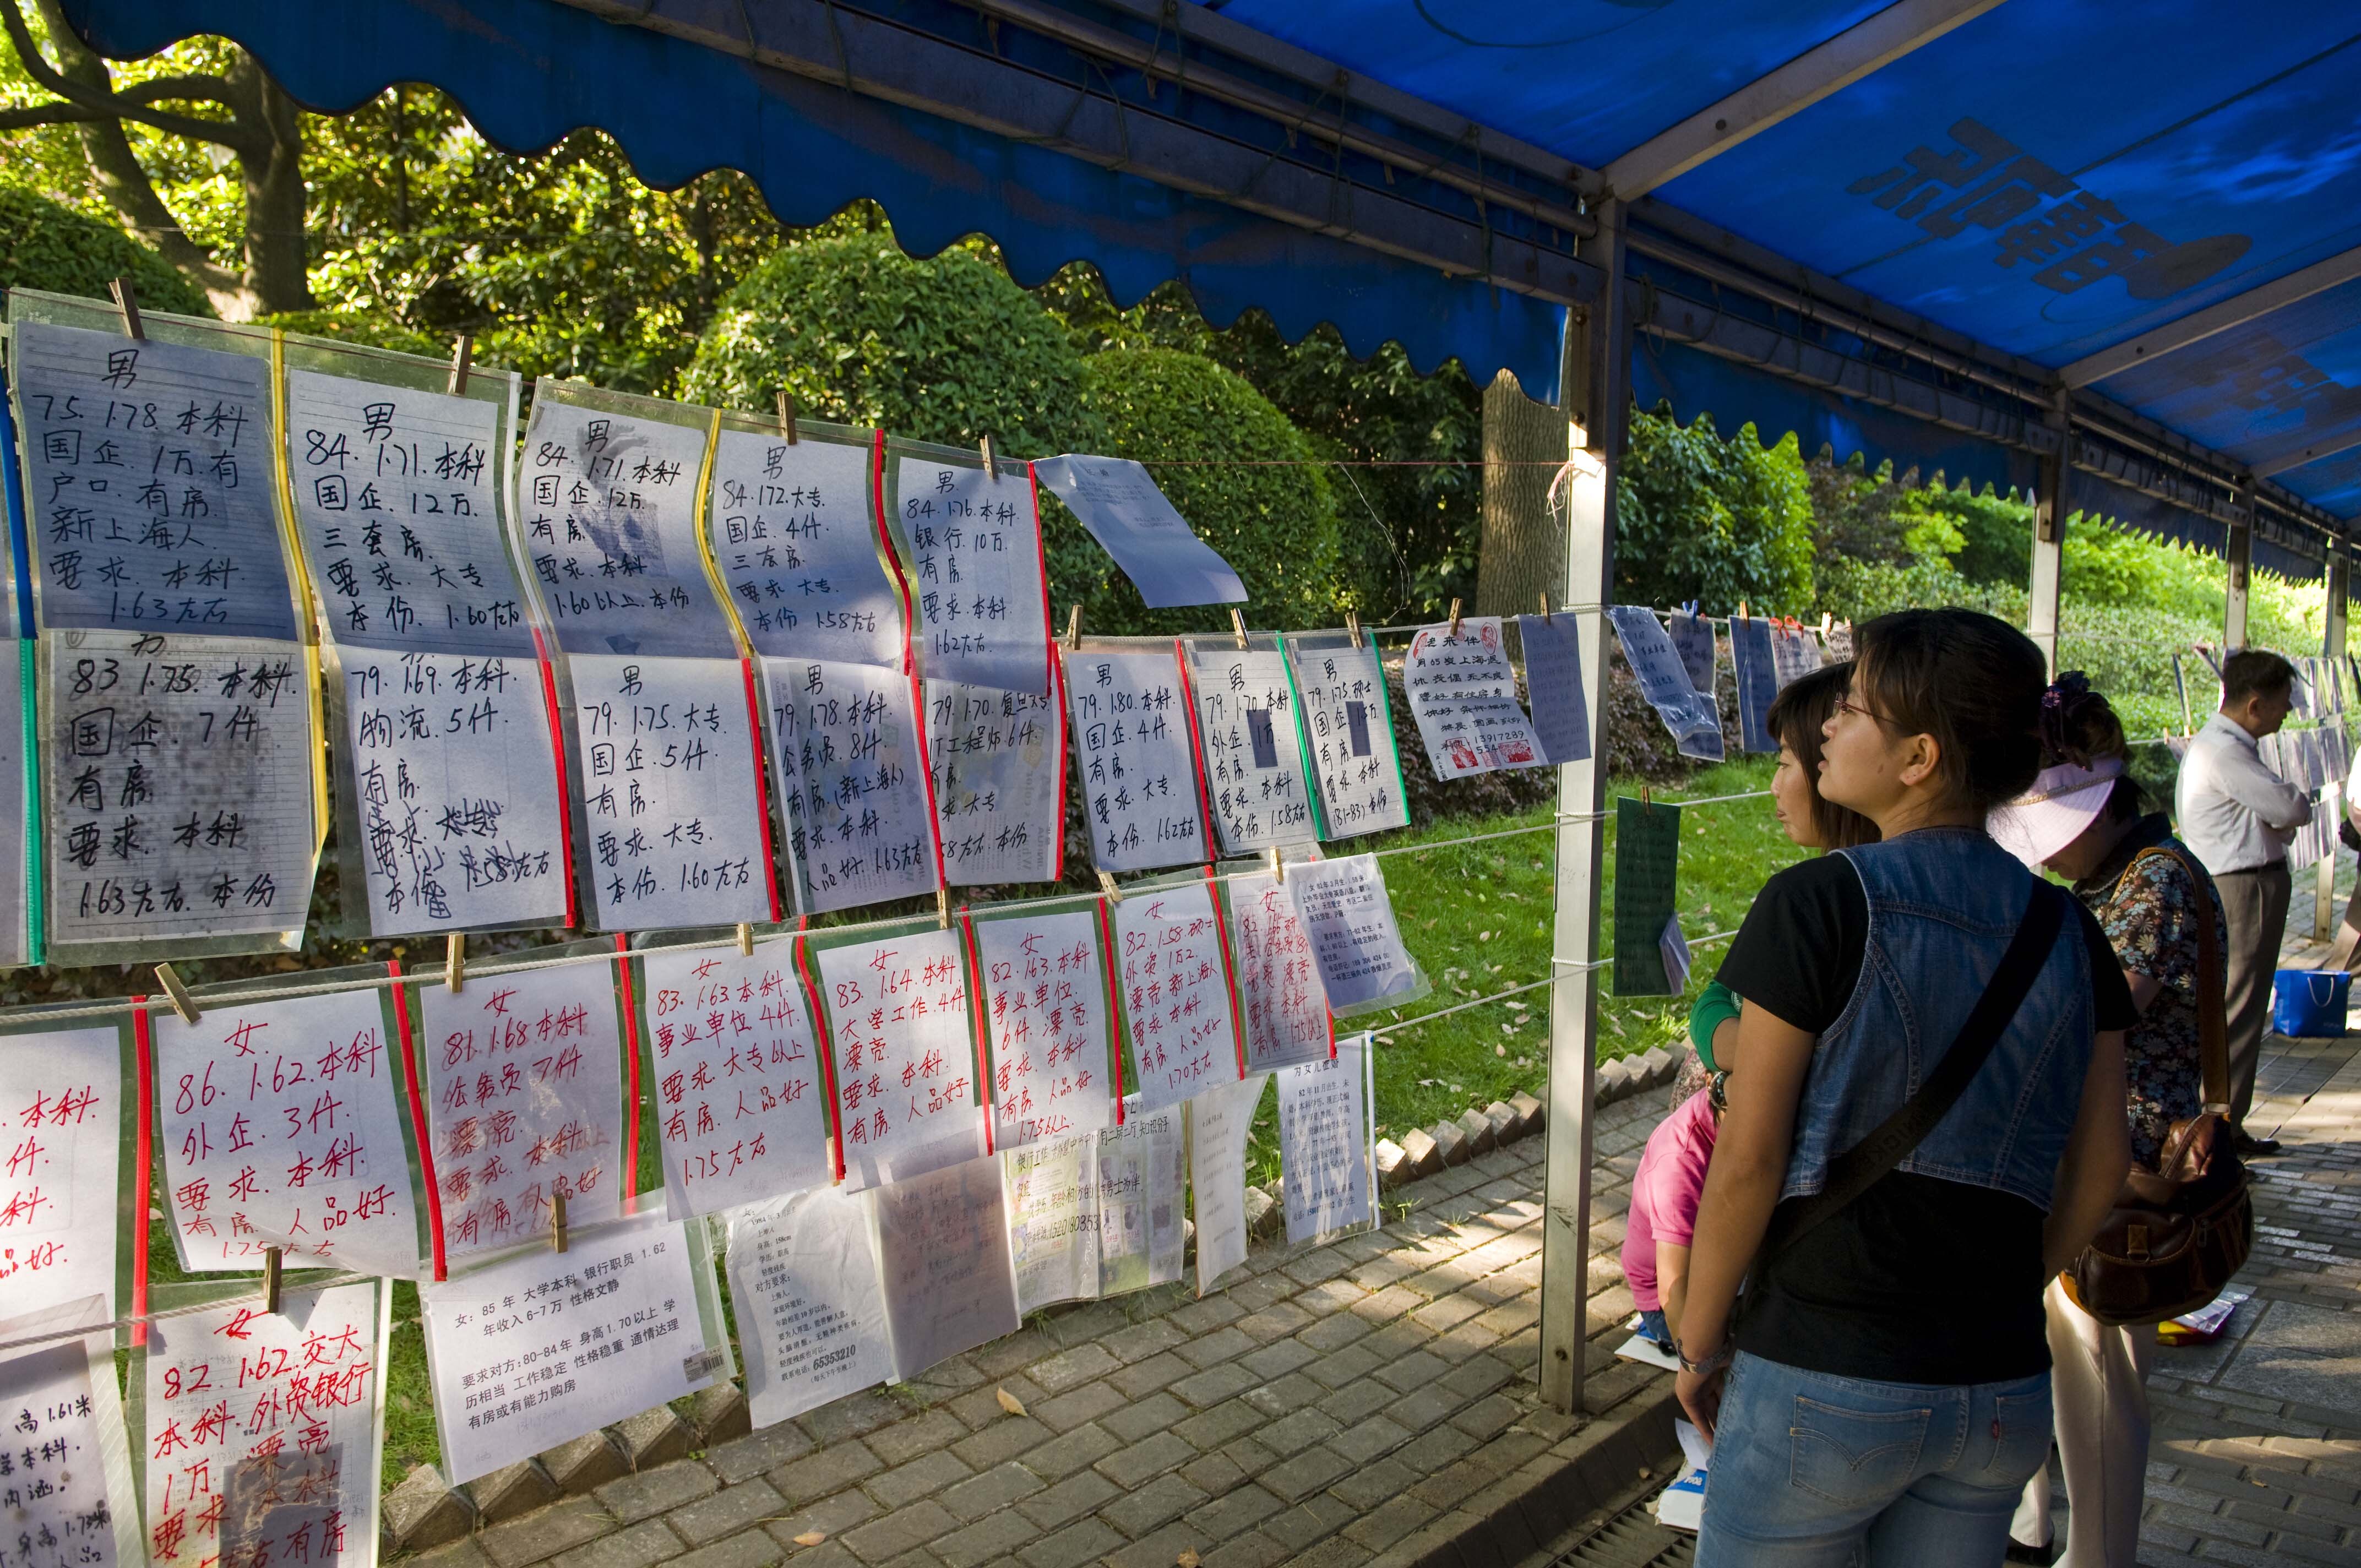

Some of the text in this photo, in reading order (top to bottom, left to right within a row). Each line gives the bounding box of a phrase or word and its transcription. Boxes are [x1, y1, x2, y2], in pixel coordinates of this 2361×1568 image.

[102, 349, 139, 389] 男
[363, 402, 395, 443] 男
[586, 420, 610, 453] 男
[763, 446, 786, 480] 男
[619, 665, 642, 696] 男
[805, 665, 823, 695] 男
[1096, 664, 1112, 688] 男
[1229, 663, 1244, 690] 男
[1324, 659, 1336, 683] 男
[1145, 901, 1164, 920] 女
[1260, 891, 1278, 912] 女
[1020, 932, 1043, 955] 女
[692, 959, 721, 980] 女
[869, 949, 898, 971] 女
[484, 989, 516, 1017] 女
[524, 1273, 578, 1302] 大学本科
[584, 1253, 634, 1281] 银行职员
[570, 1280, 620, 1307] 性格文静
[214, 1309, 269, 1340] 女
[514, 1362, 568, 1391] 工作稳定
[574, 1340, 624, 1367] 性格稳重
[630, 1319, 679, 1347] 通情达理
[469, 1379, 577, 1430] 有房或有能力购房
